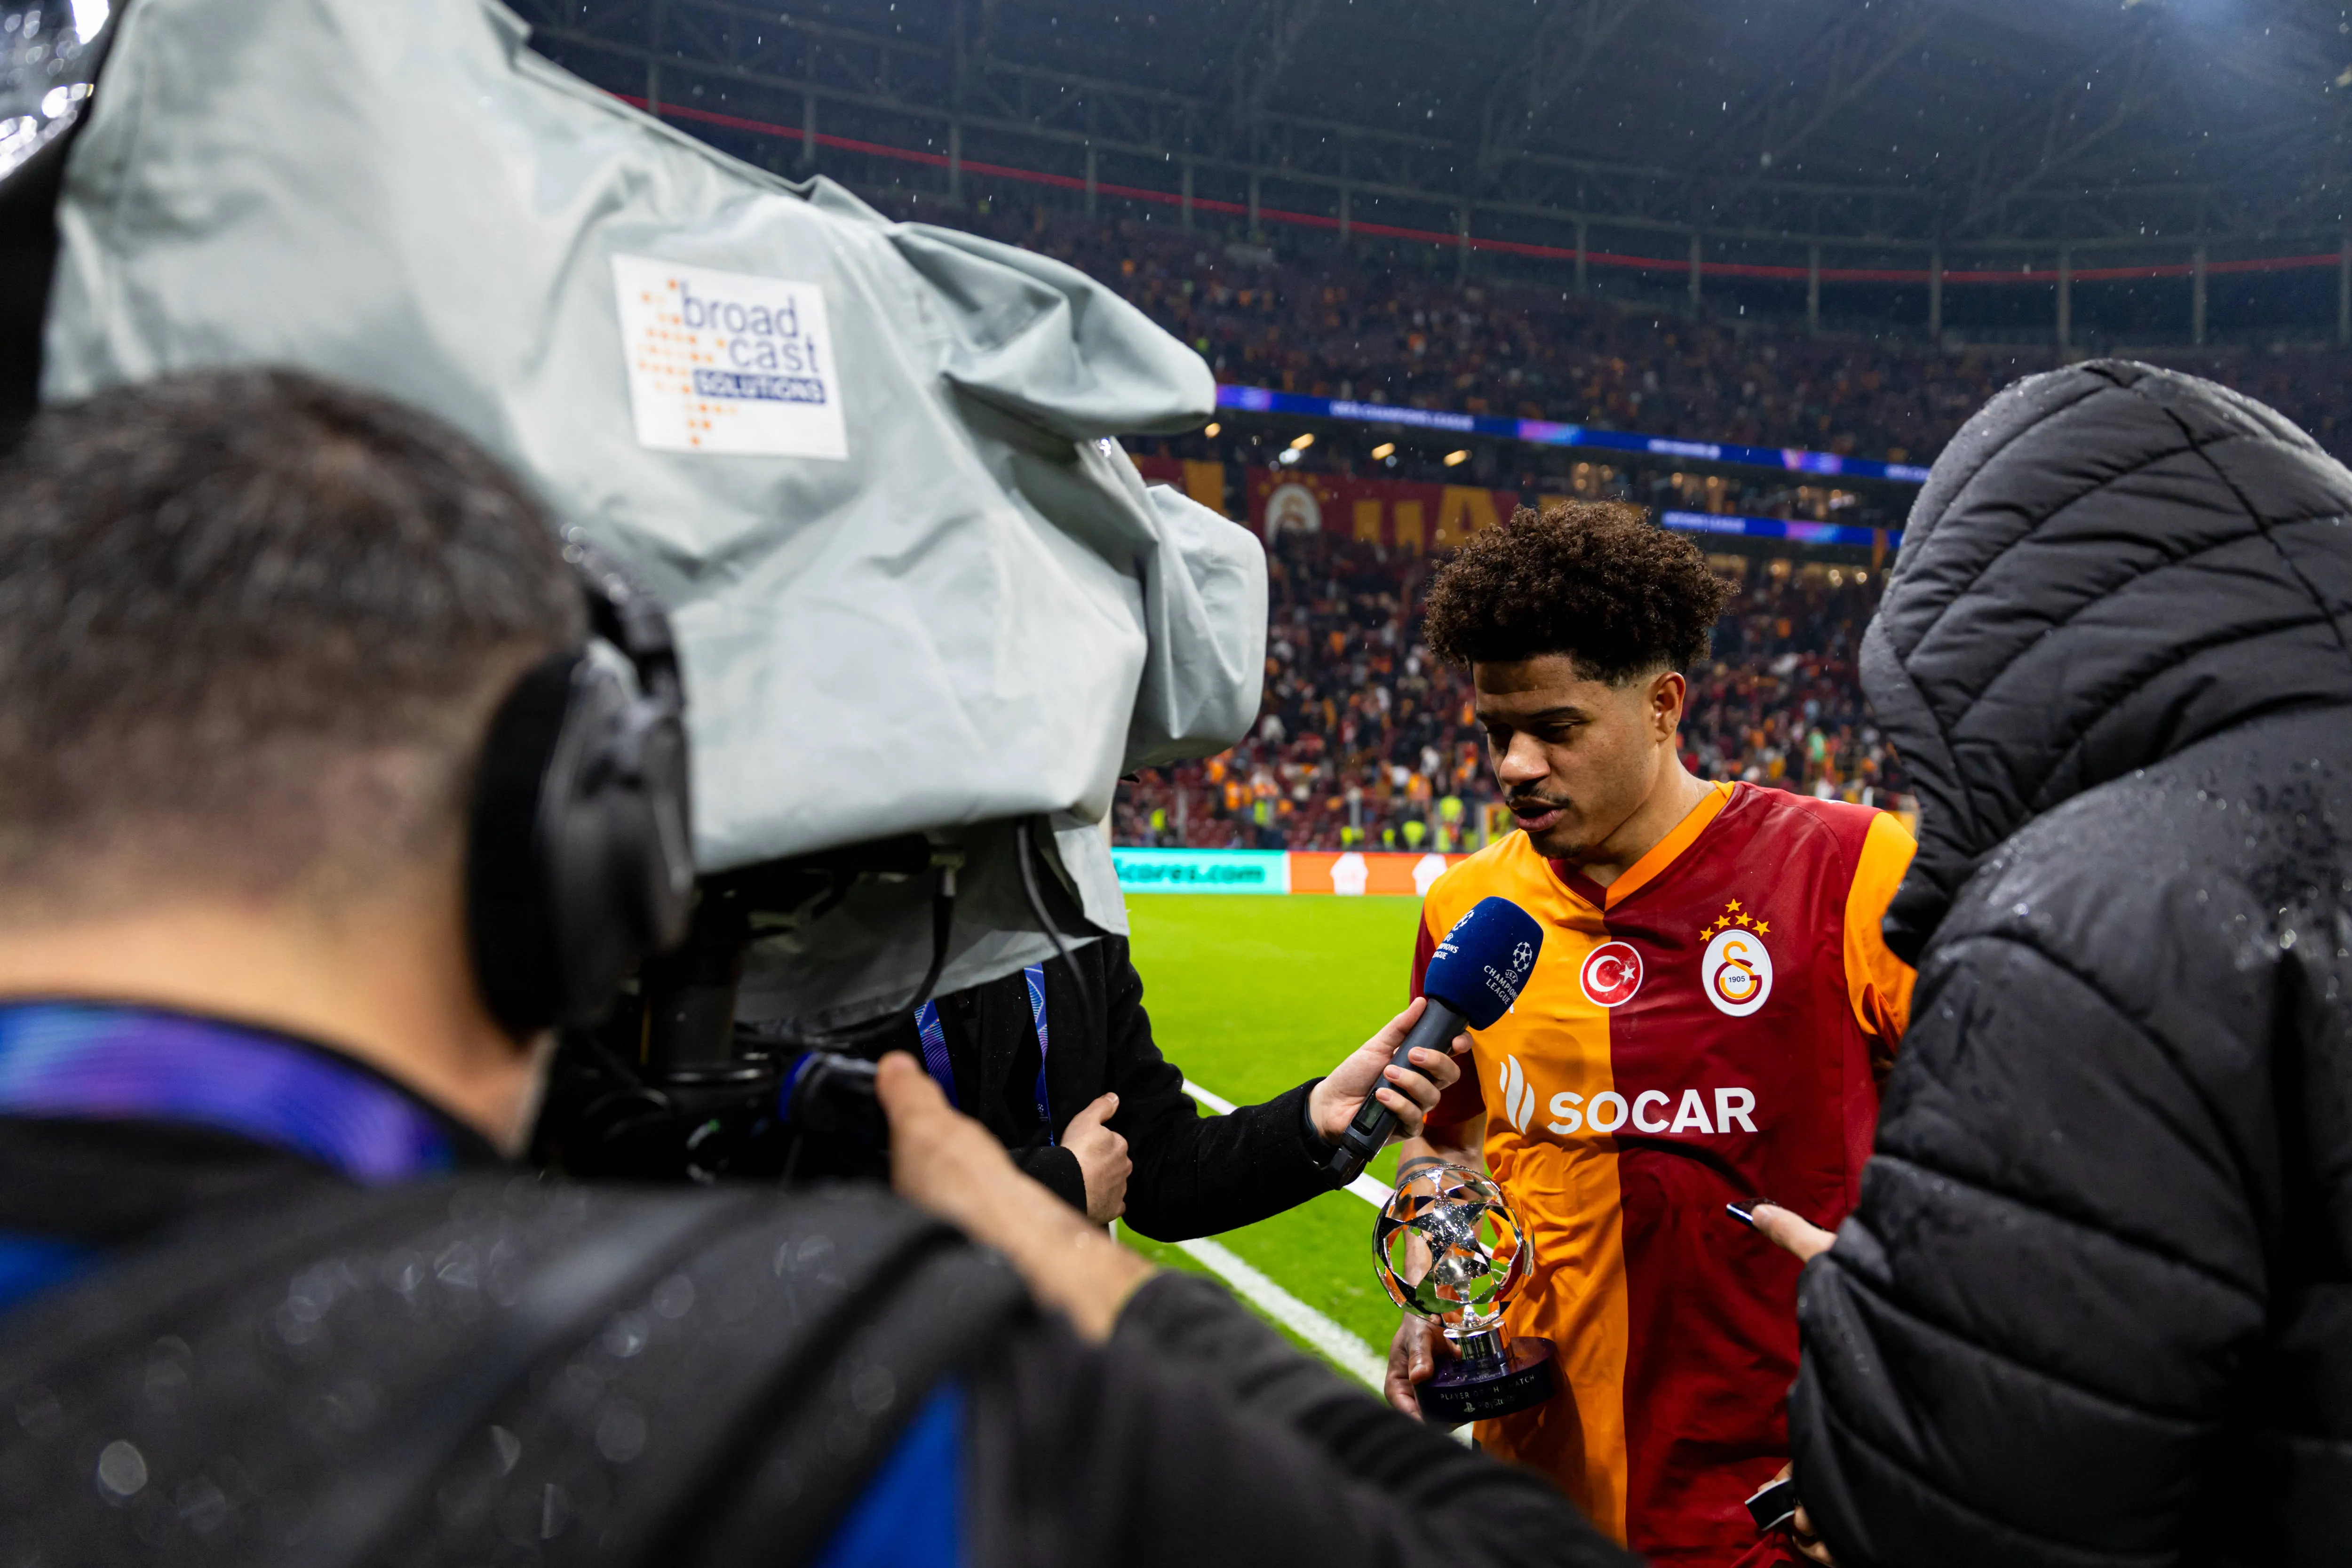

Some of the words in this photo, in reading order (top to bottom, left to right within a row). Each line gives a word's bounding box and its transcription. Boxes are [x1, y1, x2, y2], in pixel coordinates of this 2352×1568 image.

[680, 281, 798, 337] broad
[730, 334, 818, 374] cast
[1486, 978, 1510, 1005] LEAGUE
[1505, 971, 1517, 984] UEFA
[1547, 1087, 1758, 1134] SOCAR
[1440, 1392, 1470, 1401] PLAYER
